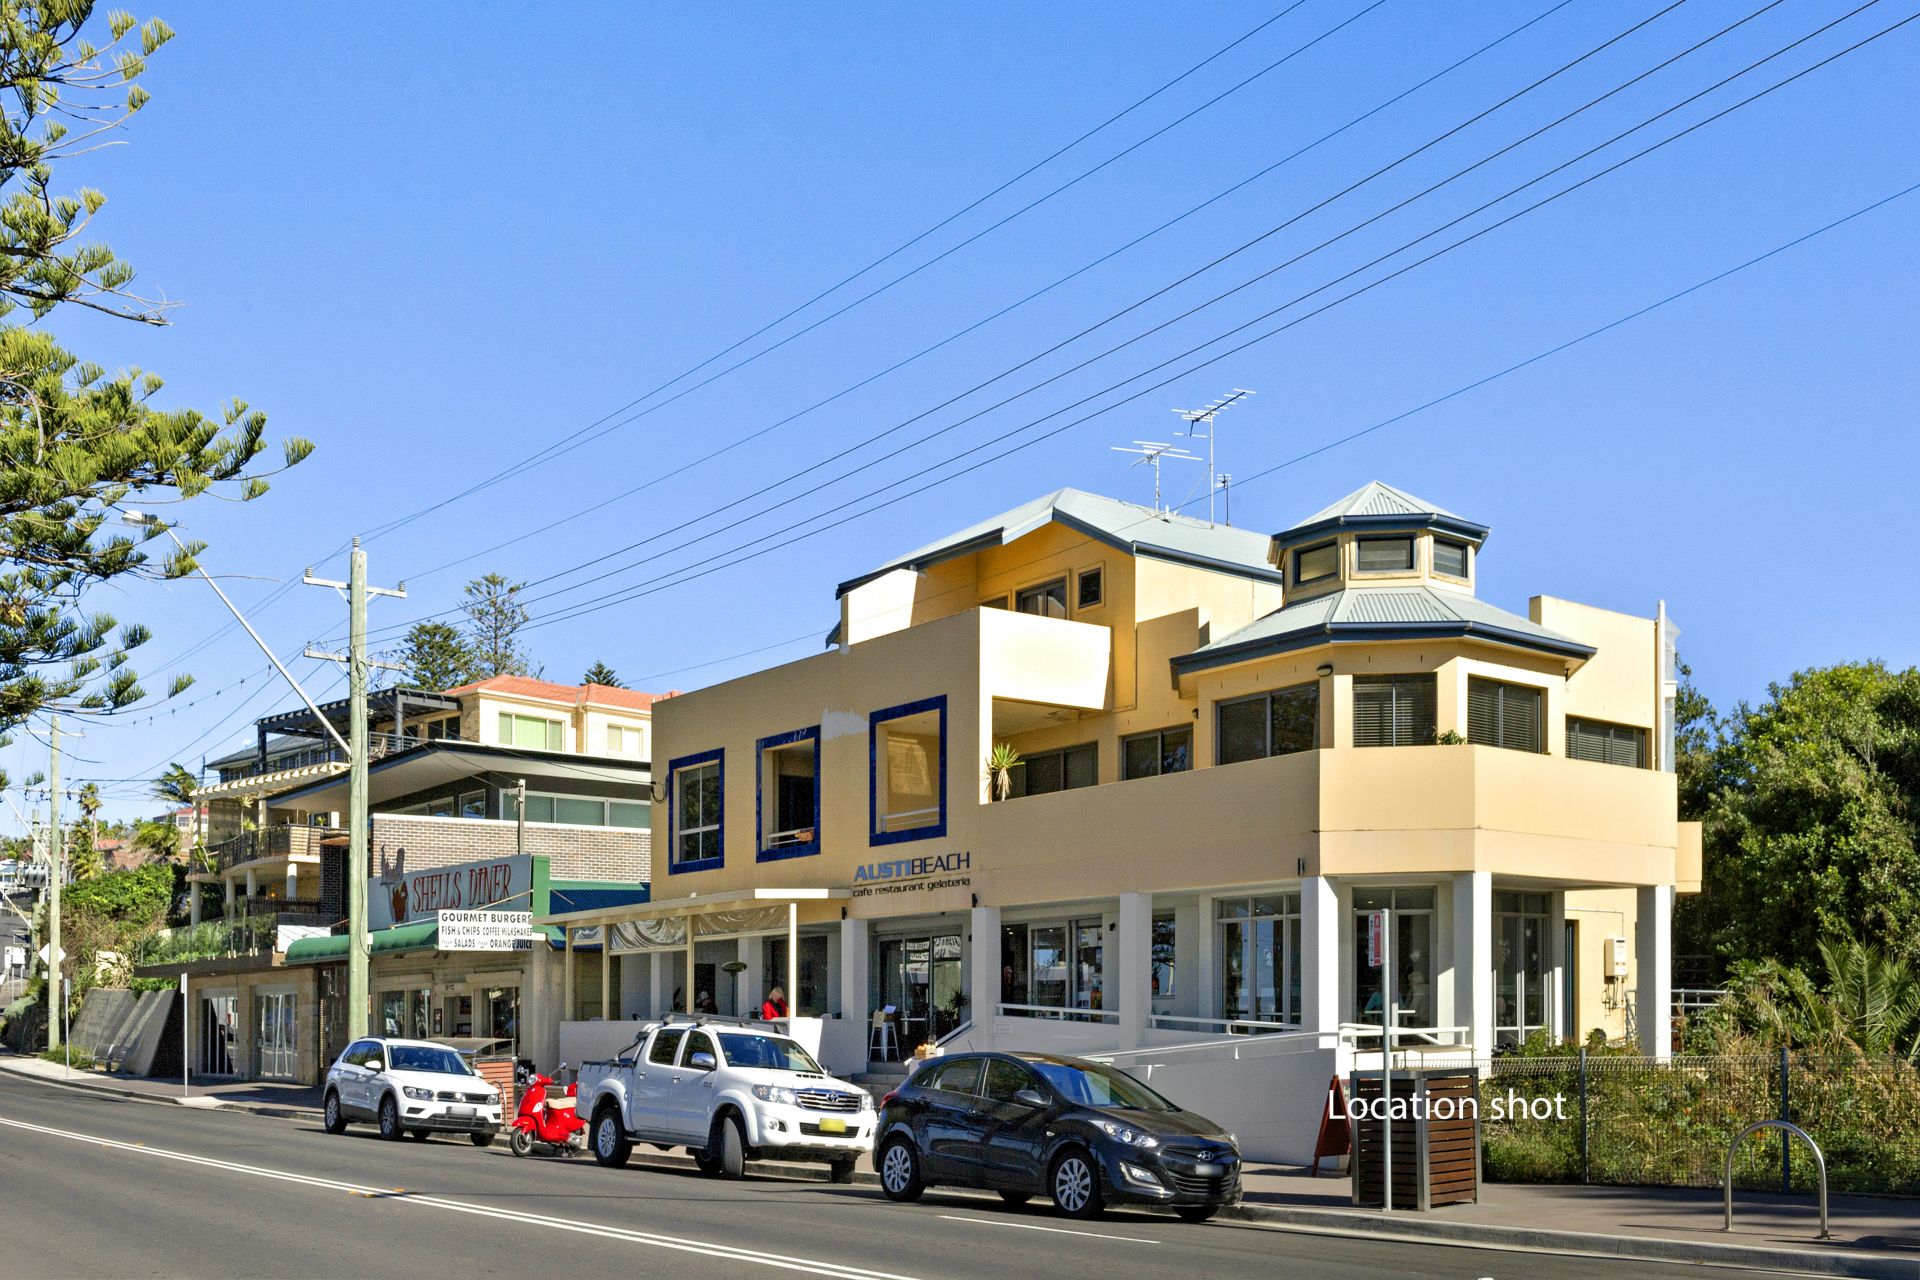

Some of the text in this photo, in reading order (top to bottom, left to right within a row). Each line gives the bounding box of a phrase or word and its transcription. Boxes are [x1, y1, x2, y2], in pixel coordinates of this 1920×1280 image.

[413, 871, 462, 912] SHELLS
[853, 876, 970, 897] cafe restaurant gelateria
[441, 912, 488, 923] GOURMET
[441, 925, 456, 936] FISH
[462, 926, 481, 936] CHIPS
[482, 927, 500, 936] COFFEE
[501, 927, 533, 937] MILKSHAKES
[454, 938, 476, 949] SALADS
[489, 939, 516, 950] ORANGE
[516, 940, 533, 950] JUICE
